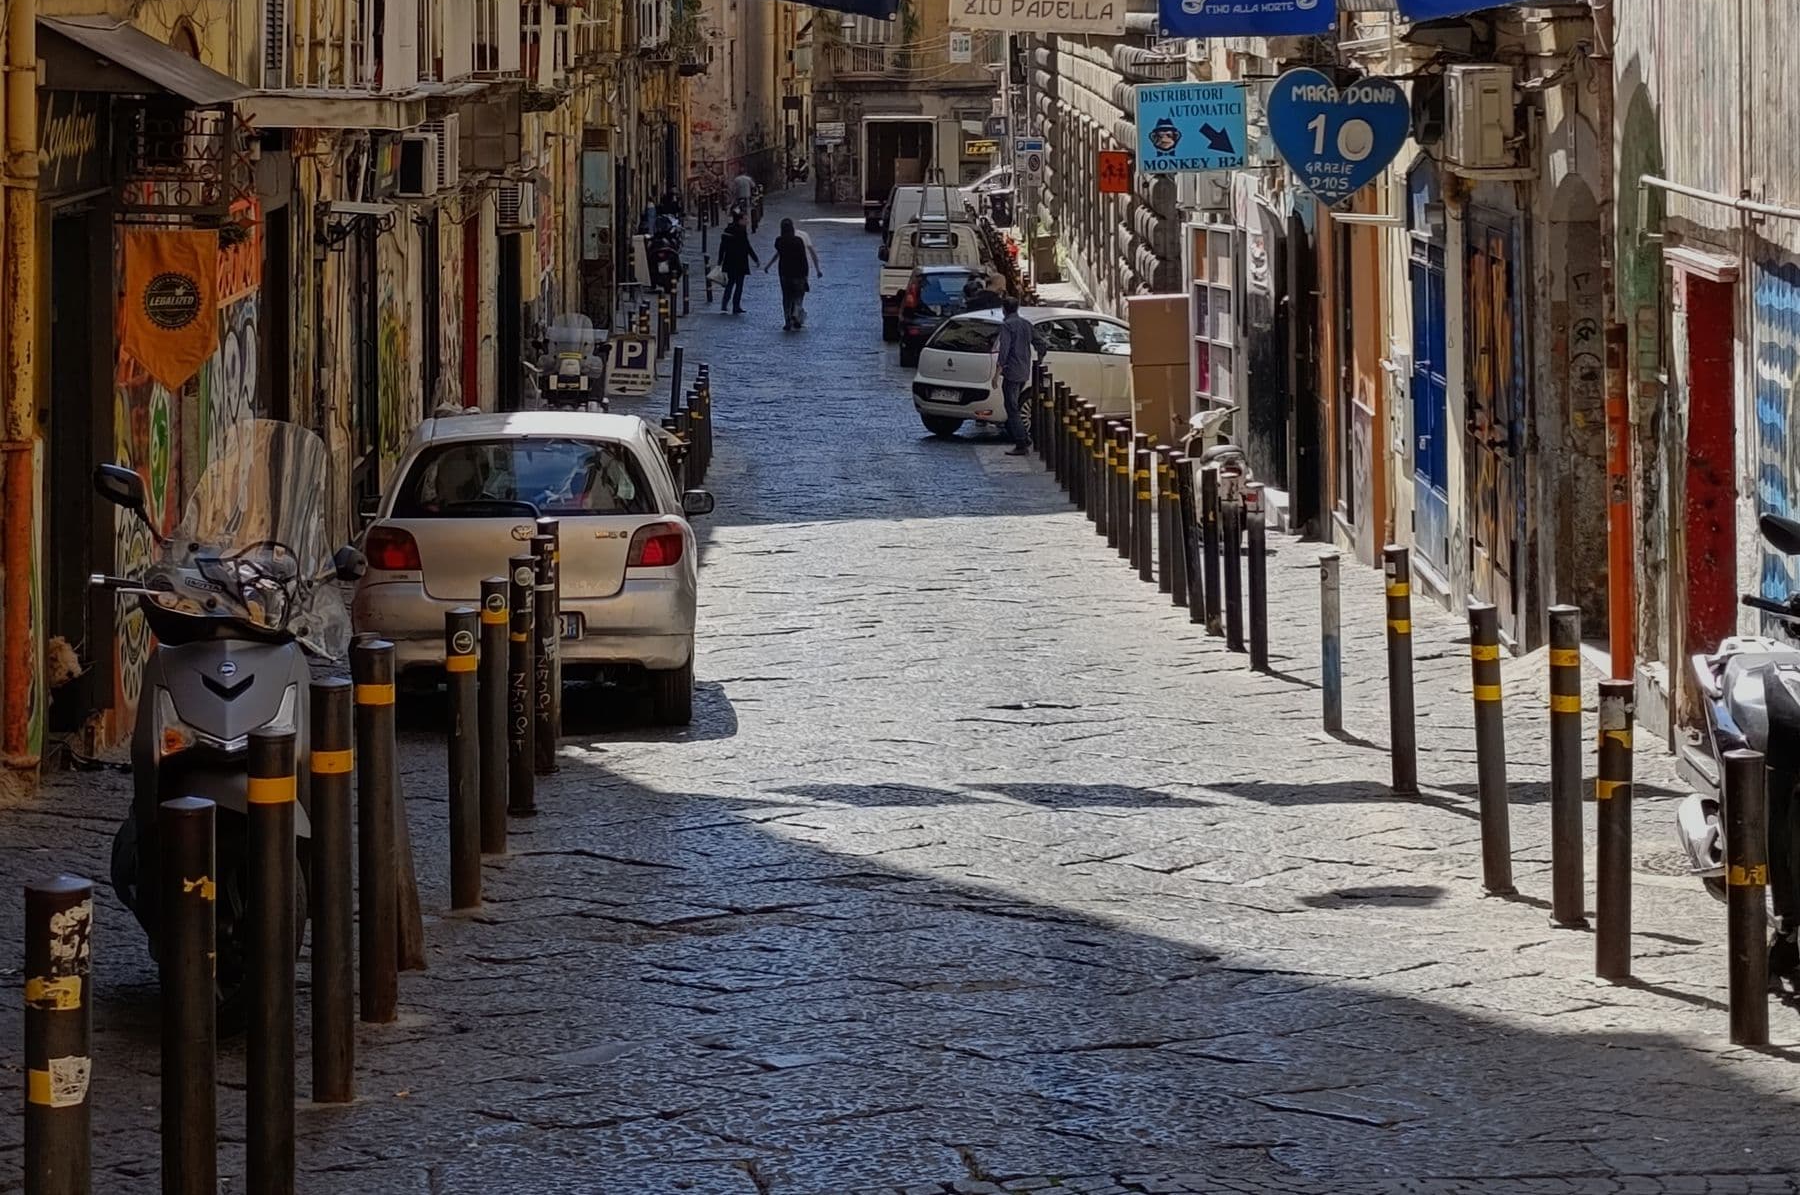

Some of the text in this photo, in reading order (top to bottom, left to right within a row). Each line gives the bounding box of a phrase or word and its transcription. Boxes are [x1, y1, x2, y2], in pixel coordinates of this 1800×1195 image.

[1011, 0, 1113, 21] PADELLA
[1205, 1, 1295, 15] FINO ALLA MORTE
[1140, 87, 1223, 103] DISTRIBUTORI
[1168, 103, 1242, 118] AUTOMATICI
[1143, 156, 1244, 172] MONKEY H24
[149, 295, 195, 307] LEGALIZED
[622, 341, 643, 367] P
